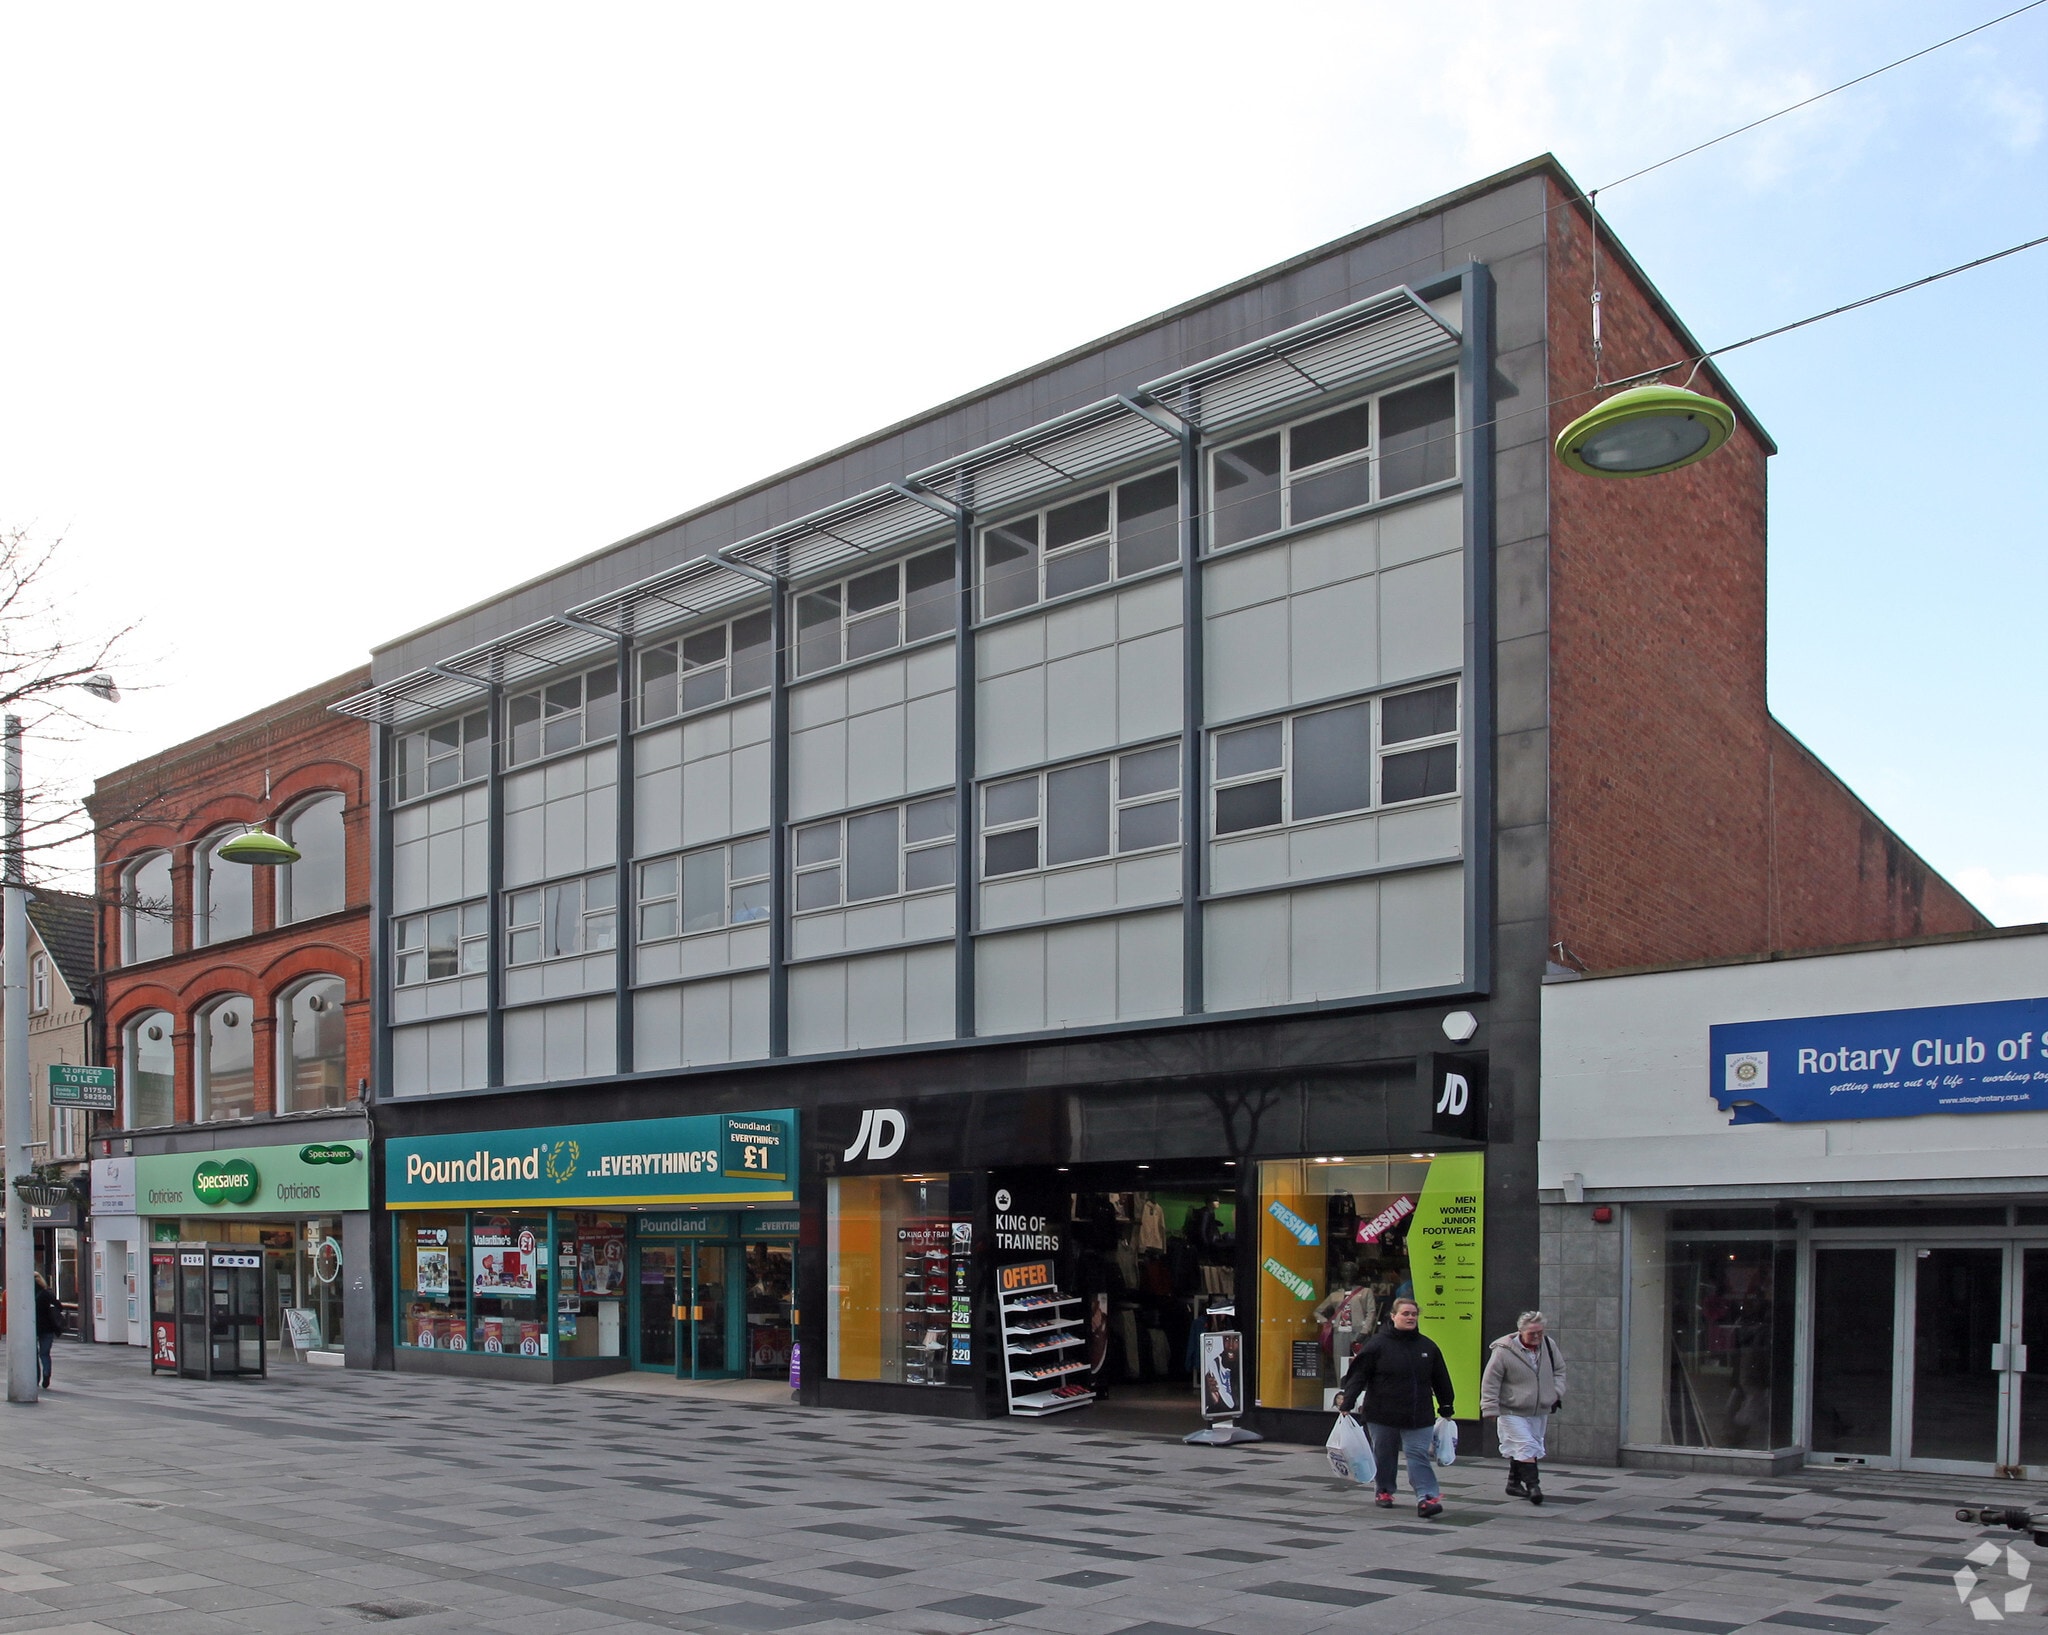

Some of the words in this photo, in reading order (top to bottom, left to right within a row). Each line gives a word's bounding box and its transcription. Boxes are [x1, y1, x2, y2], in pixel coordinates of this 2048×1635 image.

[1798, 1046, 1901, 1076] Rotary
[1911, 1036, 1985, 1067] Club
[1997, 1031, 2032, 1061] of
[65, 1074, 78, 1083] TO
[80, 1075, 100, 1084] LET
[72, 1068, 103, 1076] OFFICES
[83, 1086, 107, 1094] 01753
[1829, 1082, 1869, 1096] getting
[1872, 1081, 1900, 1089] more
[1904, 1078, 1924, 1088] out
[1926, 1075, 1940, 1090] of
[1942, 1074, 1964, 1089] life
[1982, 1070, 2031, 1084] working
[1436, 1071, 1469, 1116] JD
[1938, 1093, 2030, 1105] www.sloughrotary.org.uk
[728, 1119, 771, 1132] Poundland
[730, 1133, 780, 1145] EVERYTHING'S
[843, 1108, 906, 1162] JD
[308, 1149, 350, 1160] Specsavers
[743, 1145, 768, 1169] £1
[406, 1150, 539, 1184] Poundland
[197, 1172, 249, 1192] Specsavers
[148, 1189, 183, 1206] Opticians
[277, 1183, 321, 1202] Opticians
[1455, 1196, 1476, 1204] MEN
[1440, 1206, 1476, 1214] WOMEN
[640, 1217, 706, 1232] Poundland
[995, 1214, 1027, 1231] KING
[1029, 1216, 1046, 1232] OF
[1268, 1201, 1303, 1237] FRESH
[1300, 1226, 1318, 1245] IN
[1359, 1206, 1396, 1242] FRESH
[1395, 1196, 1414, 1217] IN
[1441, 1217, 1476, 1225] JUNIOR
[1422, 1227, 1476, 1235] FOOTWEAR
[474, 1235, 512, 1246] Valentine's
[520, 1237, 532, 1251] £1
[995, 1233, 1059, 1251] TRAINERS
[562, 1245, 574, 1254] 25
[607, 1244, 621, 1258] £1
[1003, 1264, 1048, 1289] OFFER
[1263, 1257, 1300, 1293] FRESH
[1296, 1282, 1314, 1300] IN
[952, 1301, 959, 1312] 2
[952, 1312, 970, 1324] £25
[952, 1338, 959, 1349] 2
[952, 1349, 971, 1361] £20
